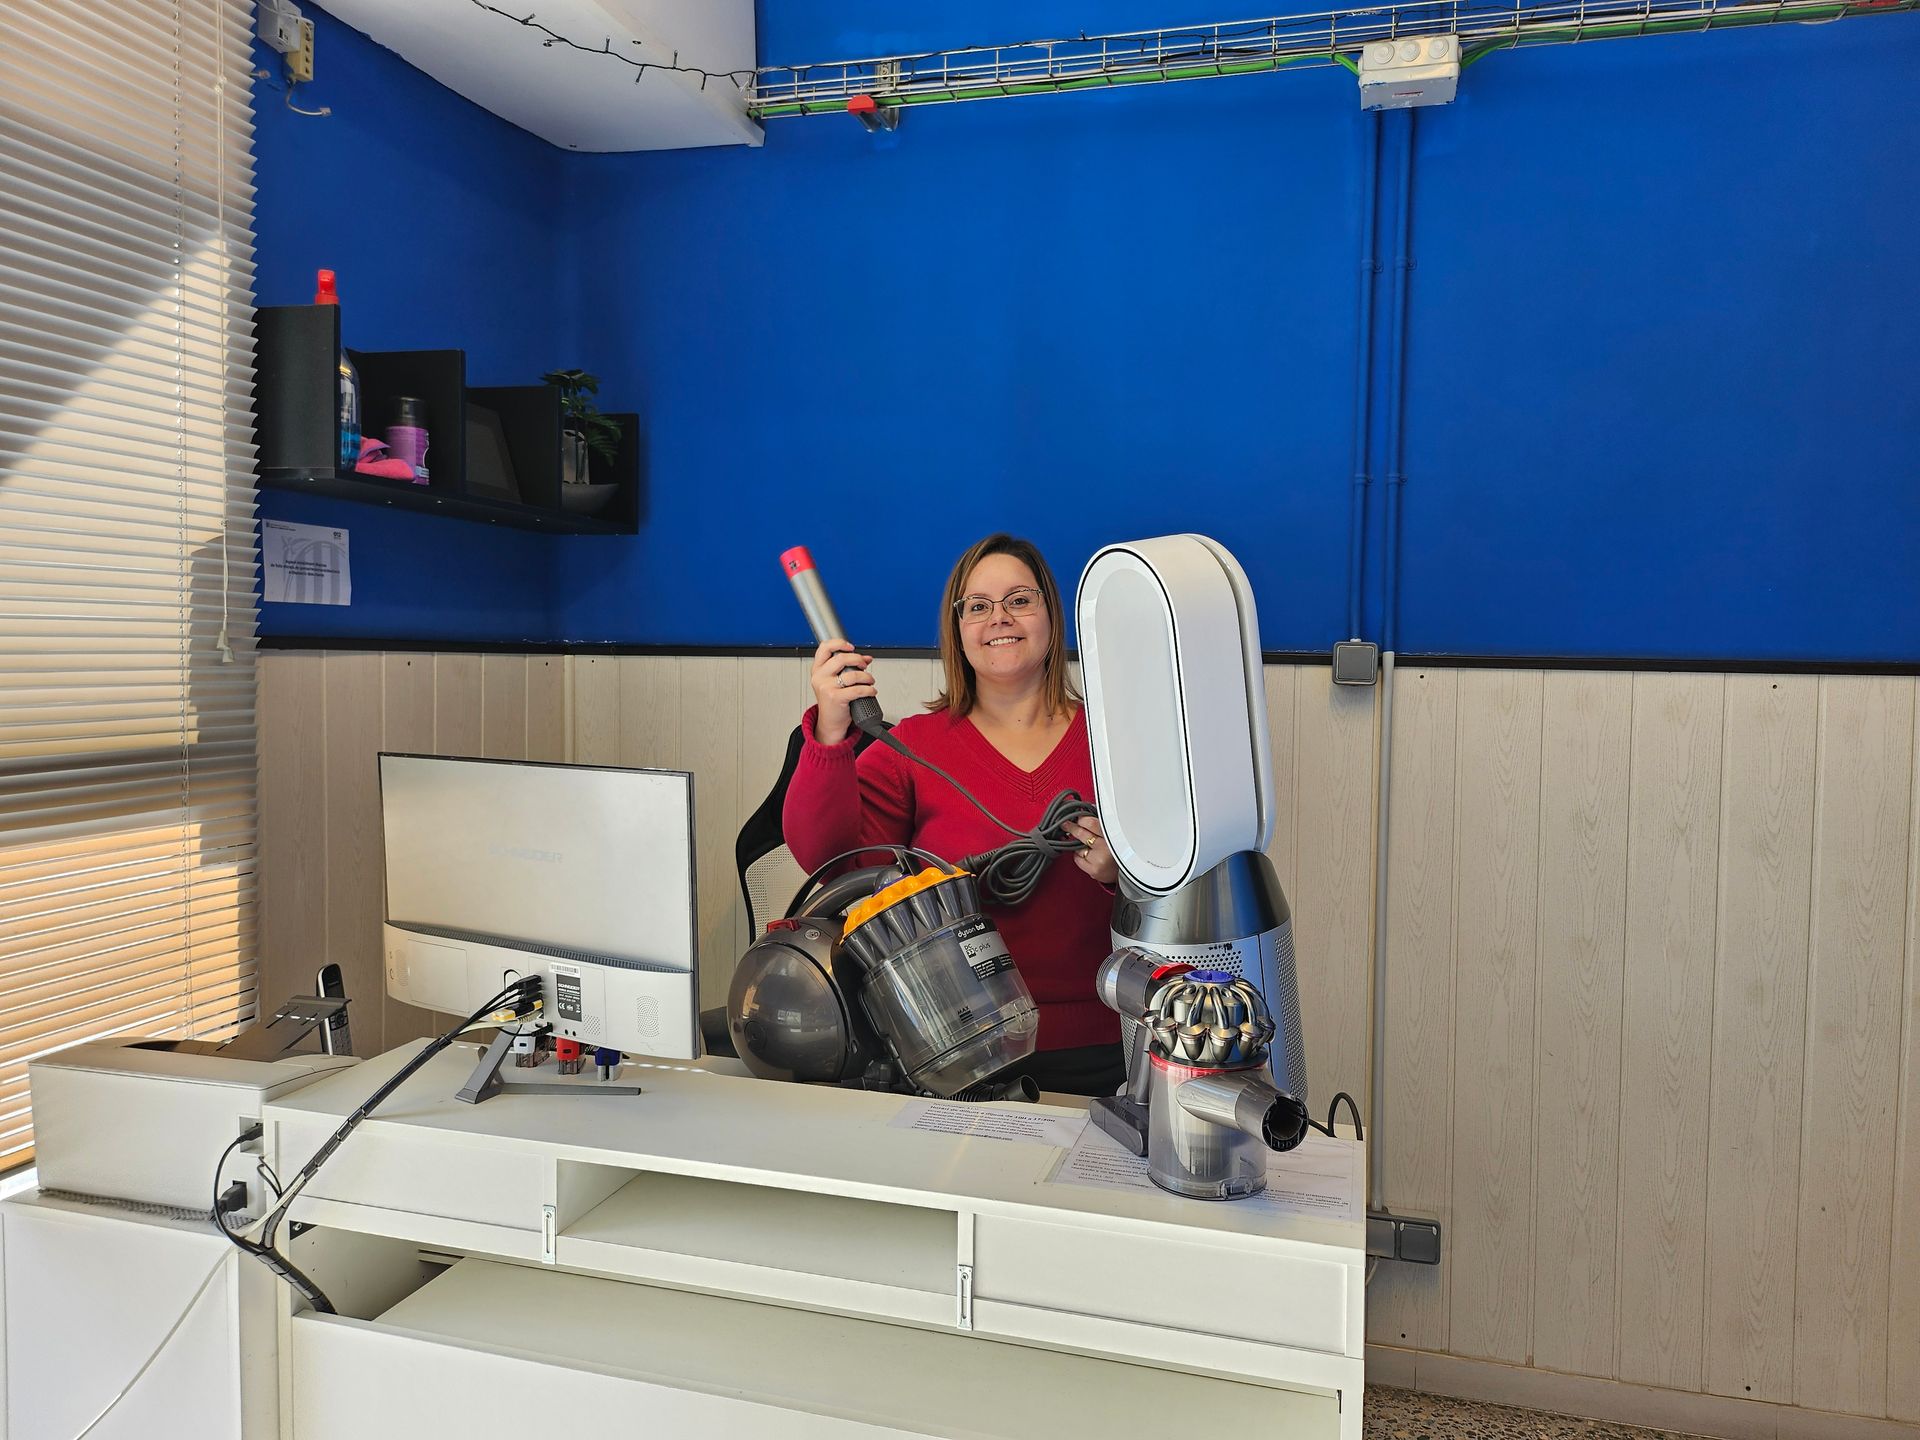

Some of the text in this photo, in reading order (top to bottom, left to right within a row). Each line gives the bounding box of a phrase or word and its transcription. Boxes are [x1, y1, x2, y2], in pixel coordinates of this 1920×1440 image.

[957, 922, 986, 938] dyson ball
[979, 942, 991, 952] plus
[957, 1006, 970, 1015] MAX
